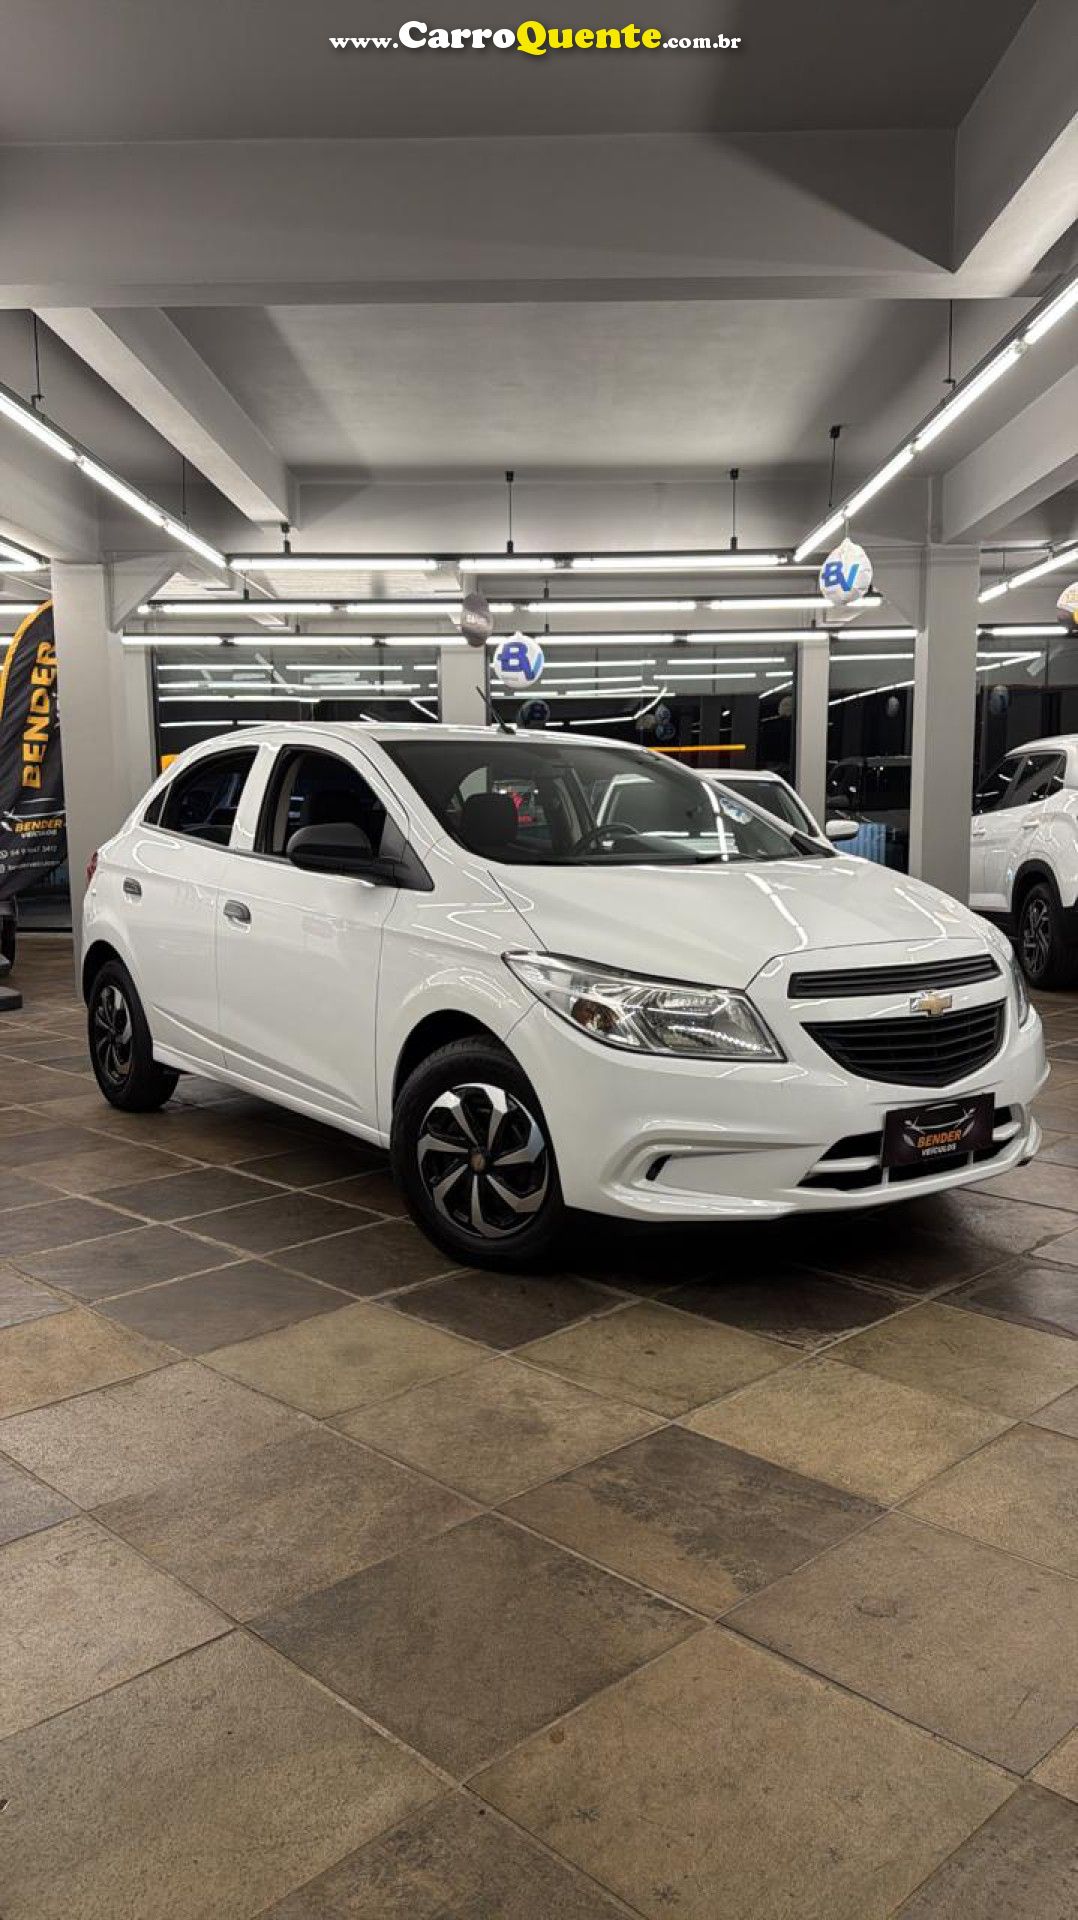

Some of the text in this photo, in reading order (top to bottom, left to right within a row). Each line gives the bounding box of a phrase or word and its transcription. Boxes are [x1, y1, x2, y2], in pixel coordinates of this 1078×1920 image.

[821, 561, 860, 592] BV
[497, 641, 545, 681] BV
[21, 641, 58, 789] BENDER
[15, 818, 64, 834] BENDER
[918, 1129, 961, 1148] BENDER
